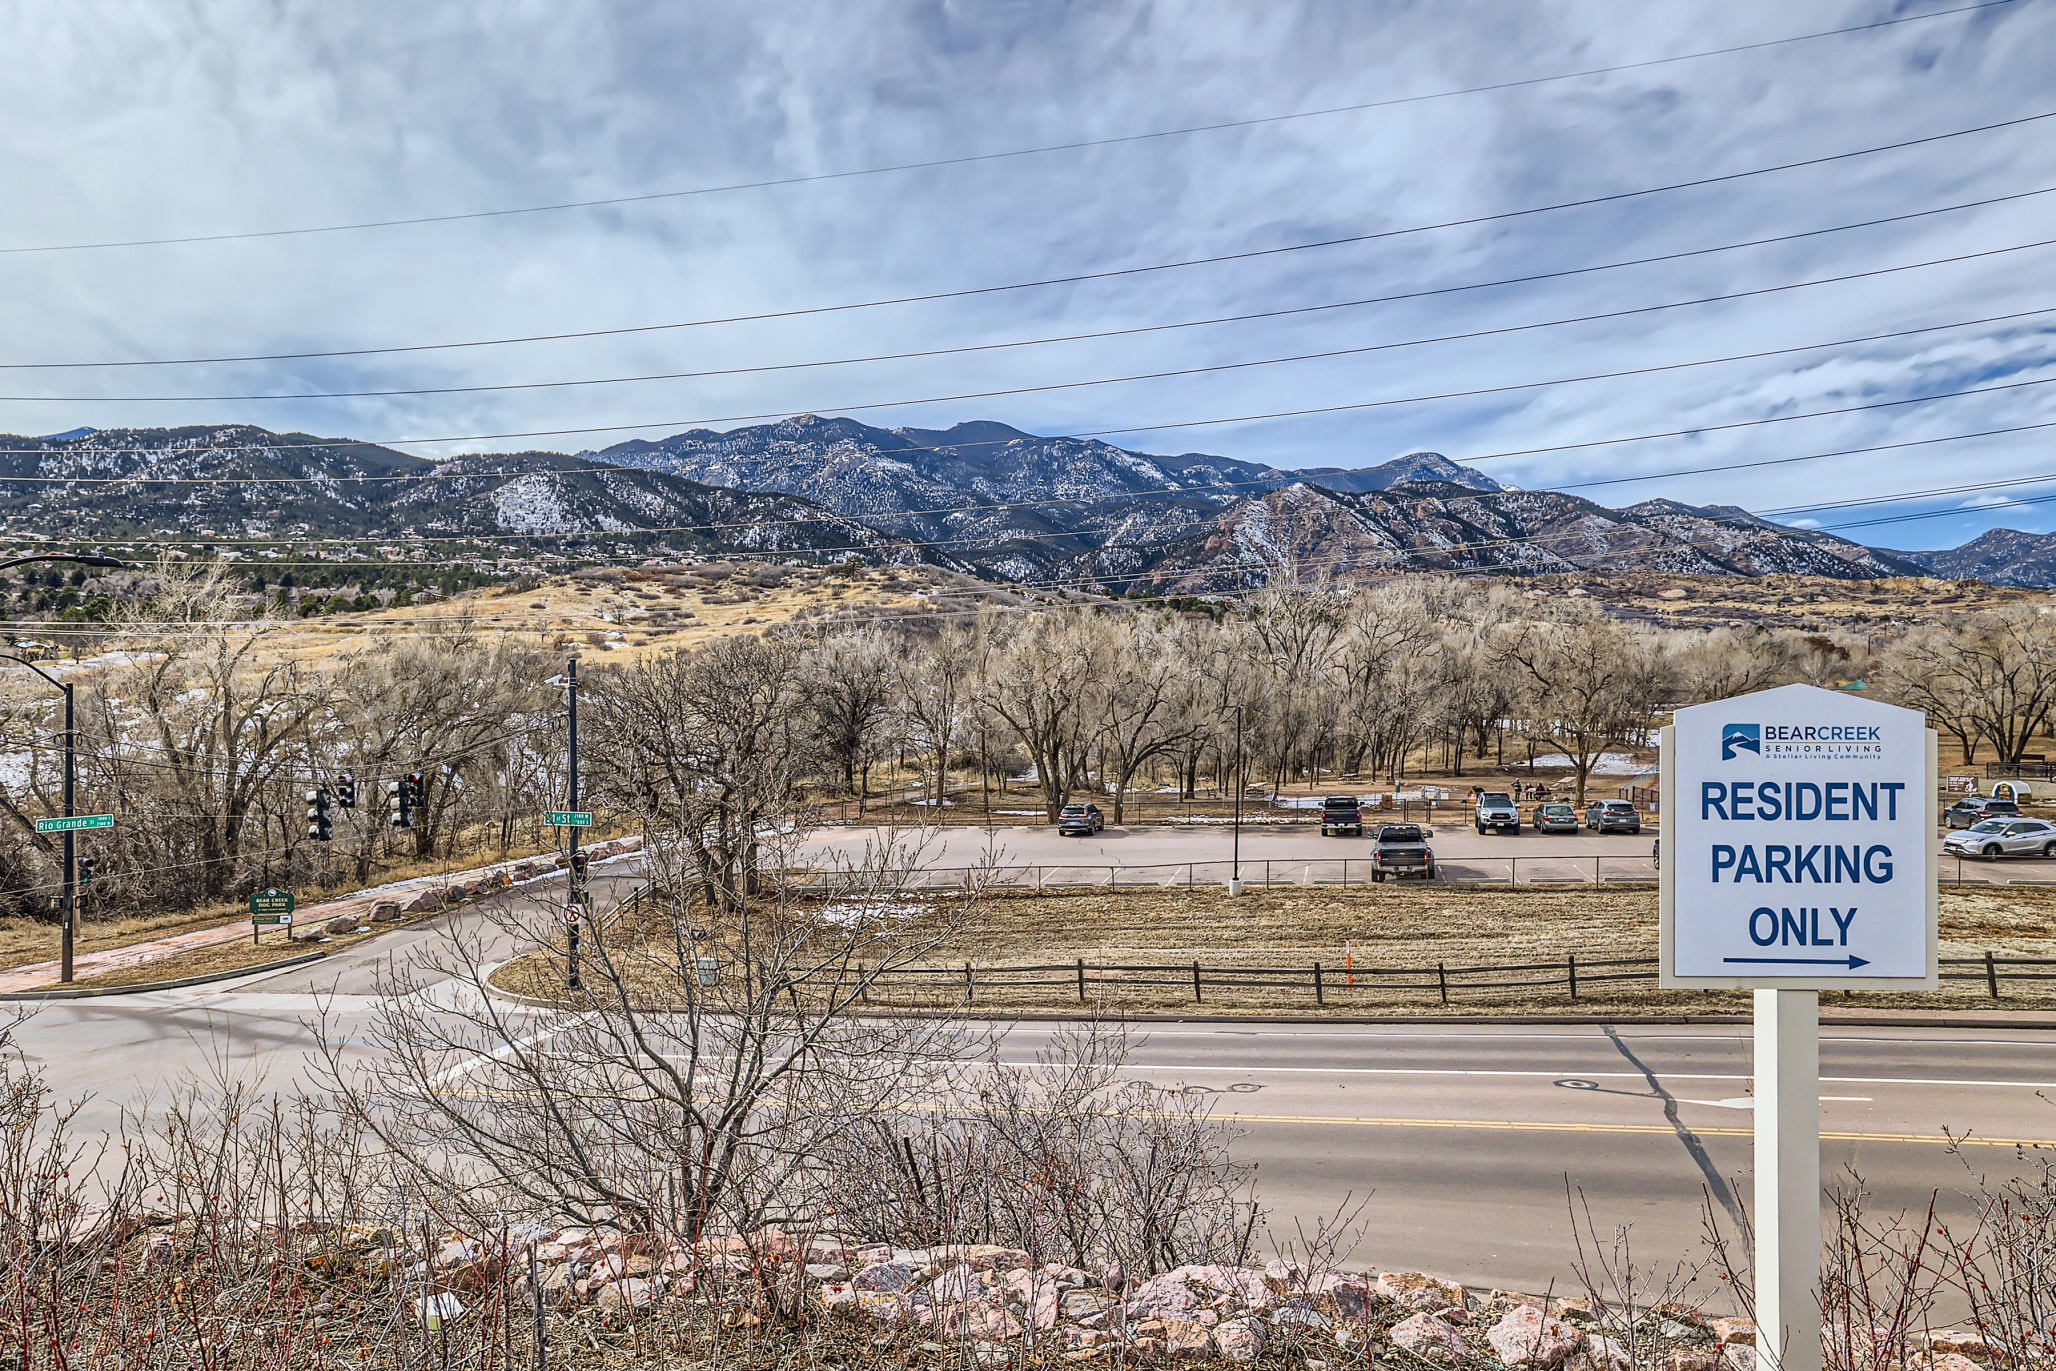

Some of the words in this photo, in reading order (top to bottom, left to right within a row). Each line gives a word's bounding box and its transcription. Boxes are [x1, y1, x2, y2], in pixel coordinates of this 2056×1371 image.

[1765, 726, 1881, 740] BEARCREEK
[1765, 745, 1822, 753] SENIOR
[1828, 745, 1882, 753] LIVING
[1701, 781, 1906, 821] RESIDENT
[38, 822, 53, 831] Rio
[56, 819, 87, 829] Grande
[562, 814, 570, 823] St
[1711, 844, 1894, 884] PARKING
[1748, 906, 1858, 947] ONLY
